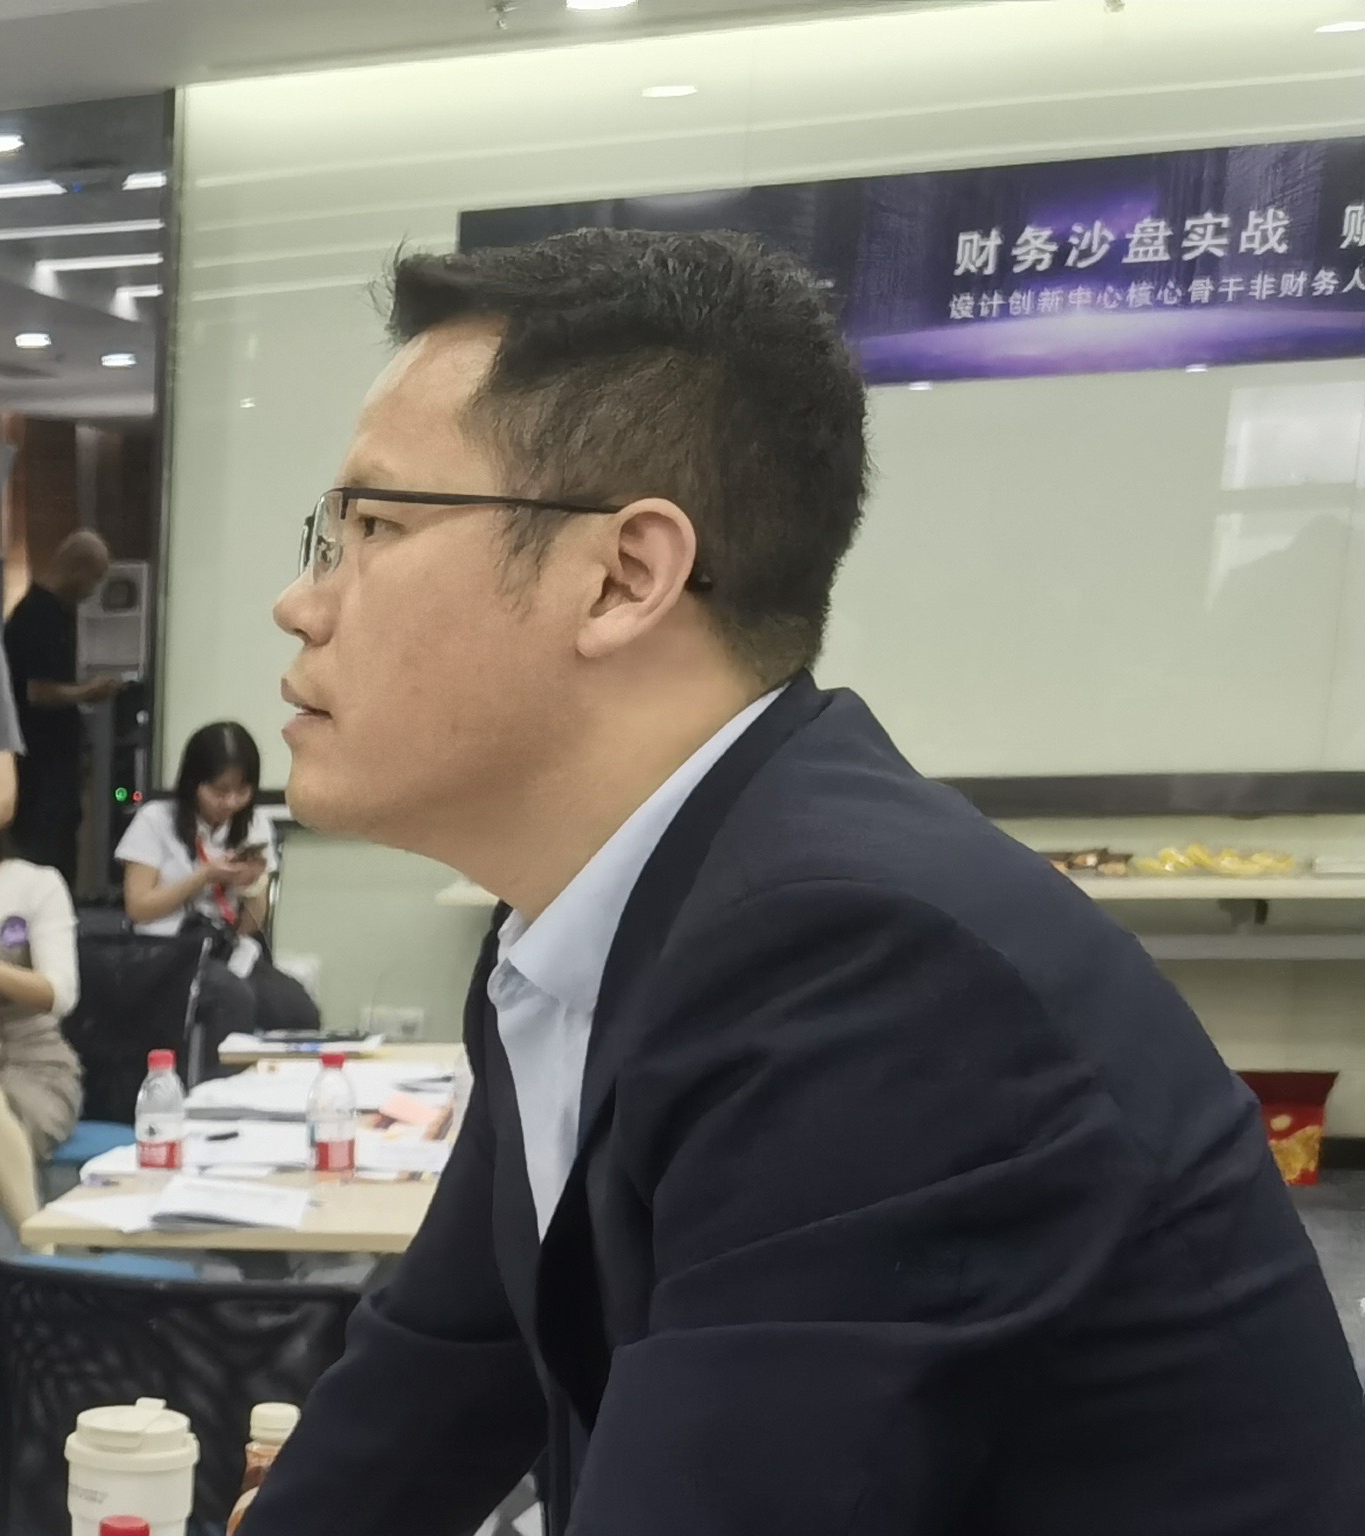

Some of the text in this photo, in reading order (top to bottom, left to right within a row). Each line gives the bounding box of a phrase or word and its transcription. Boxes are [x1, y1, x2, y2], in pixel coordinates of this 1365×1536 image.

[953, 208, 1290, 276] 财务沙盘实战
